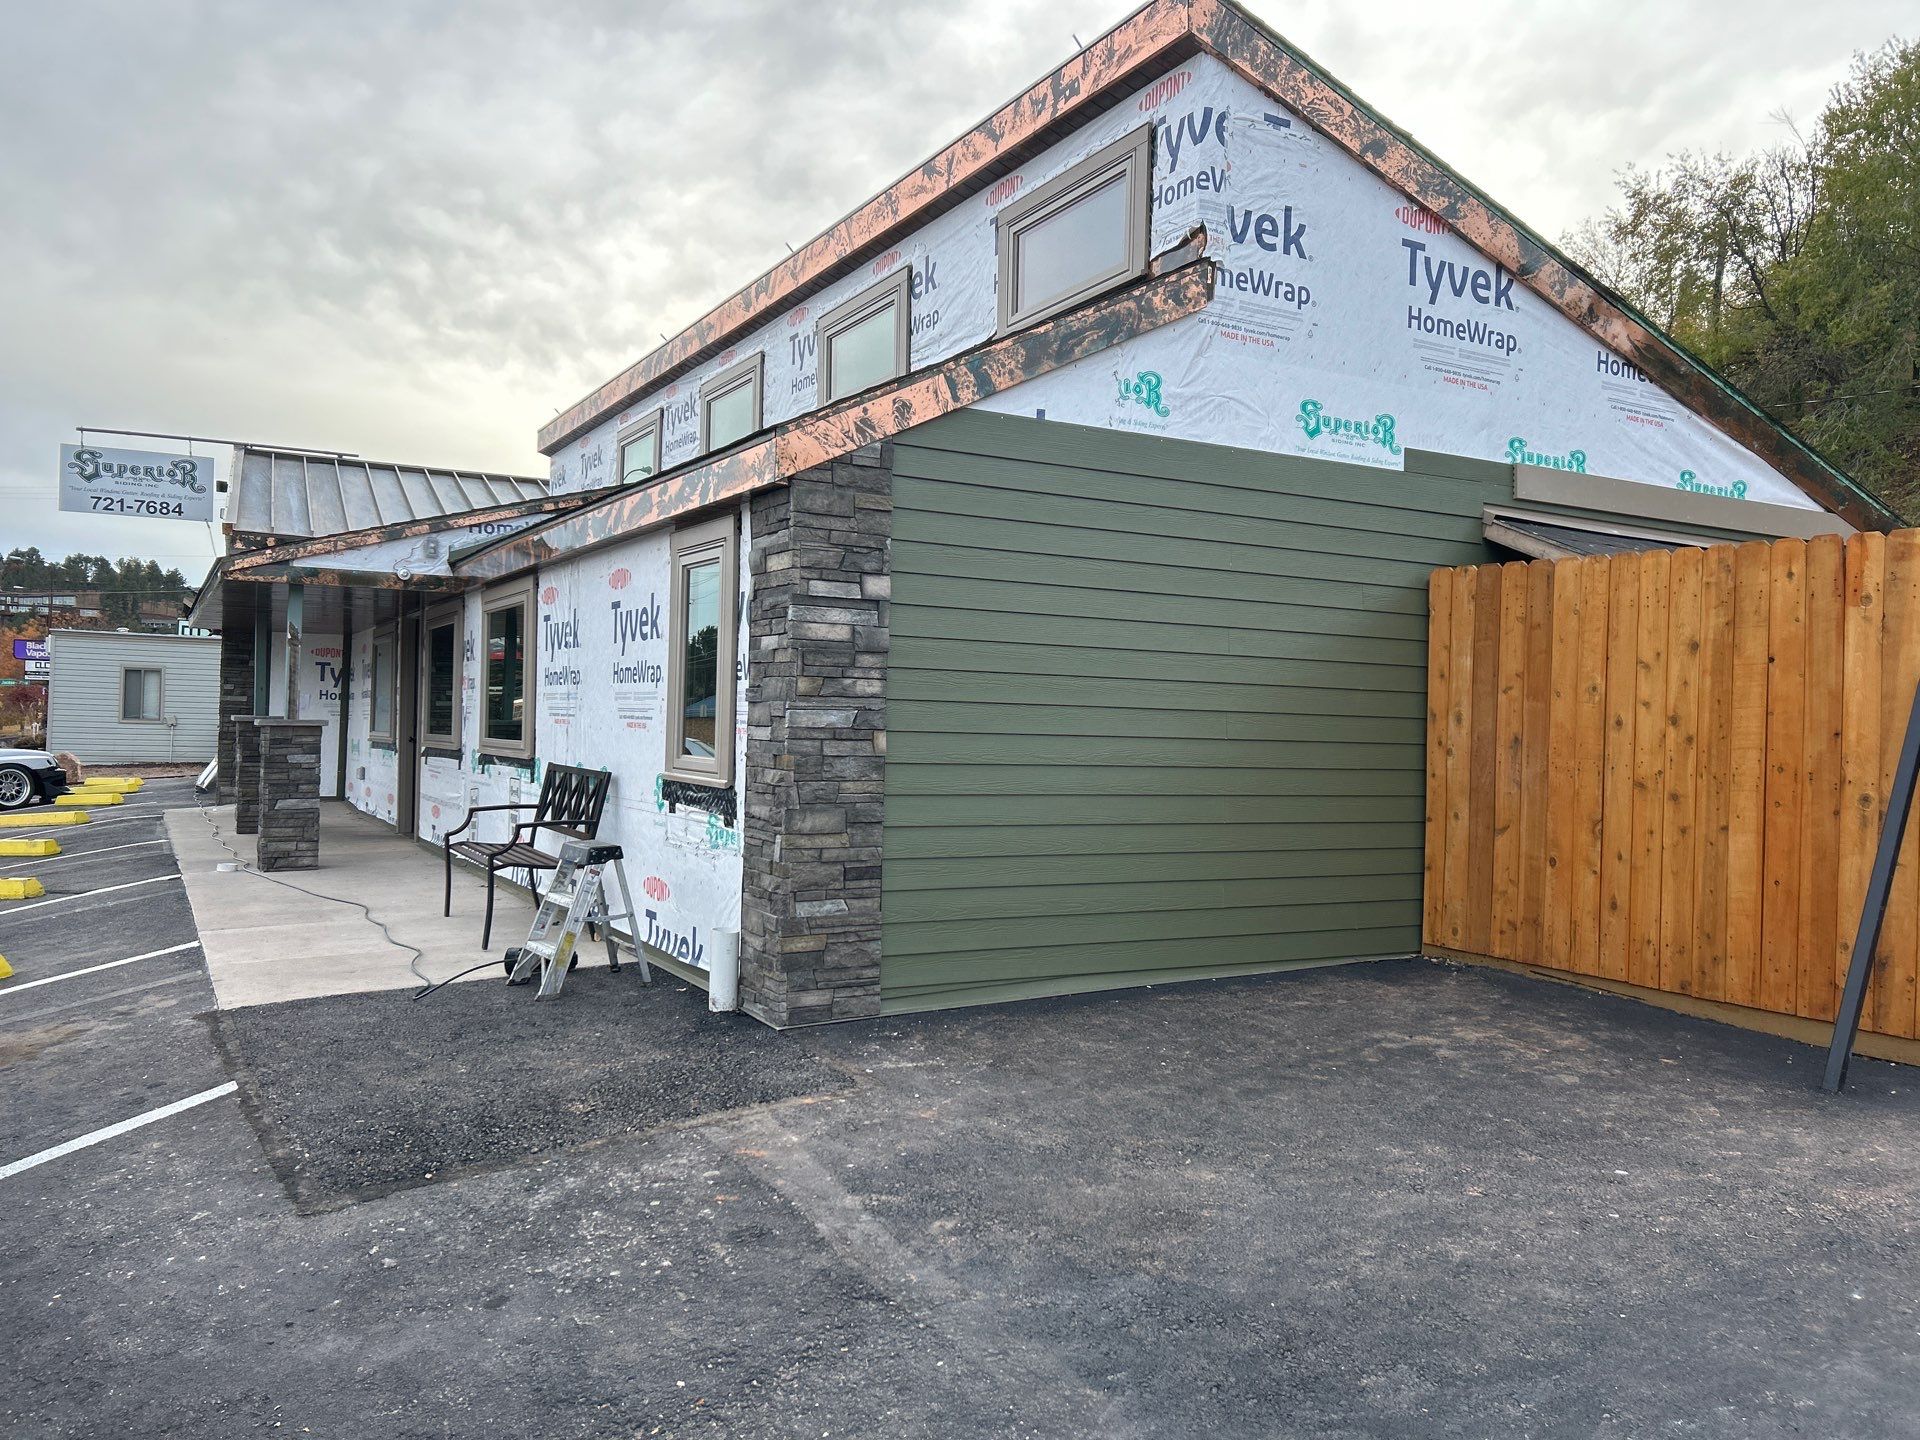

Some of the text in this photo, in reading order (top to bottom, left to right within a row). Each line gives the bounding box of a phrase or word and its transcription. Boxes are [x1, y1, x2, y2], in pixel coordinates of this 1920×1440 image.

[1145, 71, 1187, 111] DUPONT
[989, 175, 1019, 206] DUPONT
[1227, 205, 1307, 260] vek
[1215, 266, 1311, 310] meWrap
[1402, 237, 1514, 311] Tyvek
[911, 309, 940, 336] Wrap
[1220, 330, 1275, 348] MADE IN THE USA
[1408, 305, 1517, 357] HomeWrap
[789, 331, 818, 371] Tyv
[791, 368, 818, 395] Home
[666, 391, 697, 436] Tyvek
[90, 495, 184, 517] 721-7684
[543, 608, 580, 662] Tyvek
[611, 592, 661, 656] Tyvek
[26, 649, 50, 658] Vapo
[612, 660, 662, 688] HomeWrap
